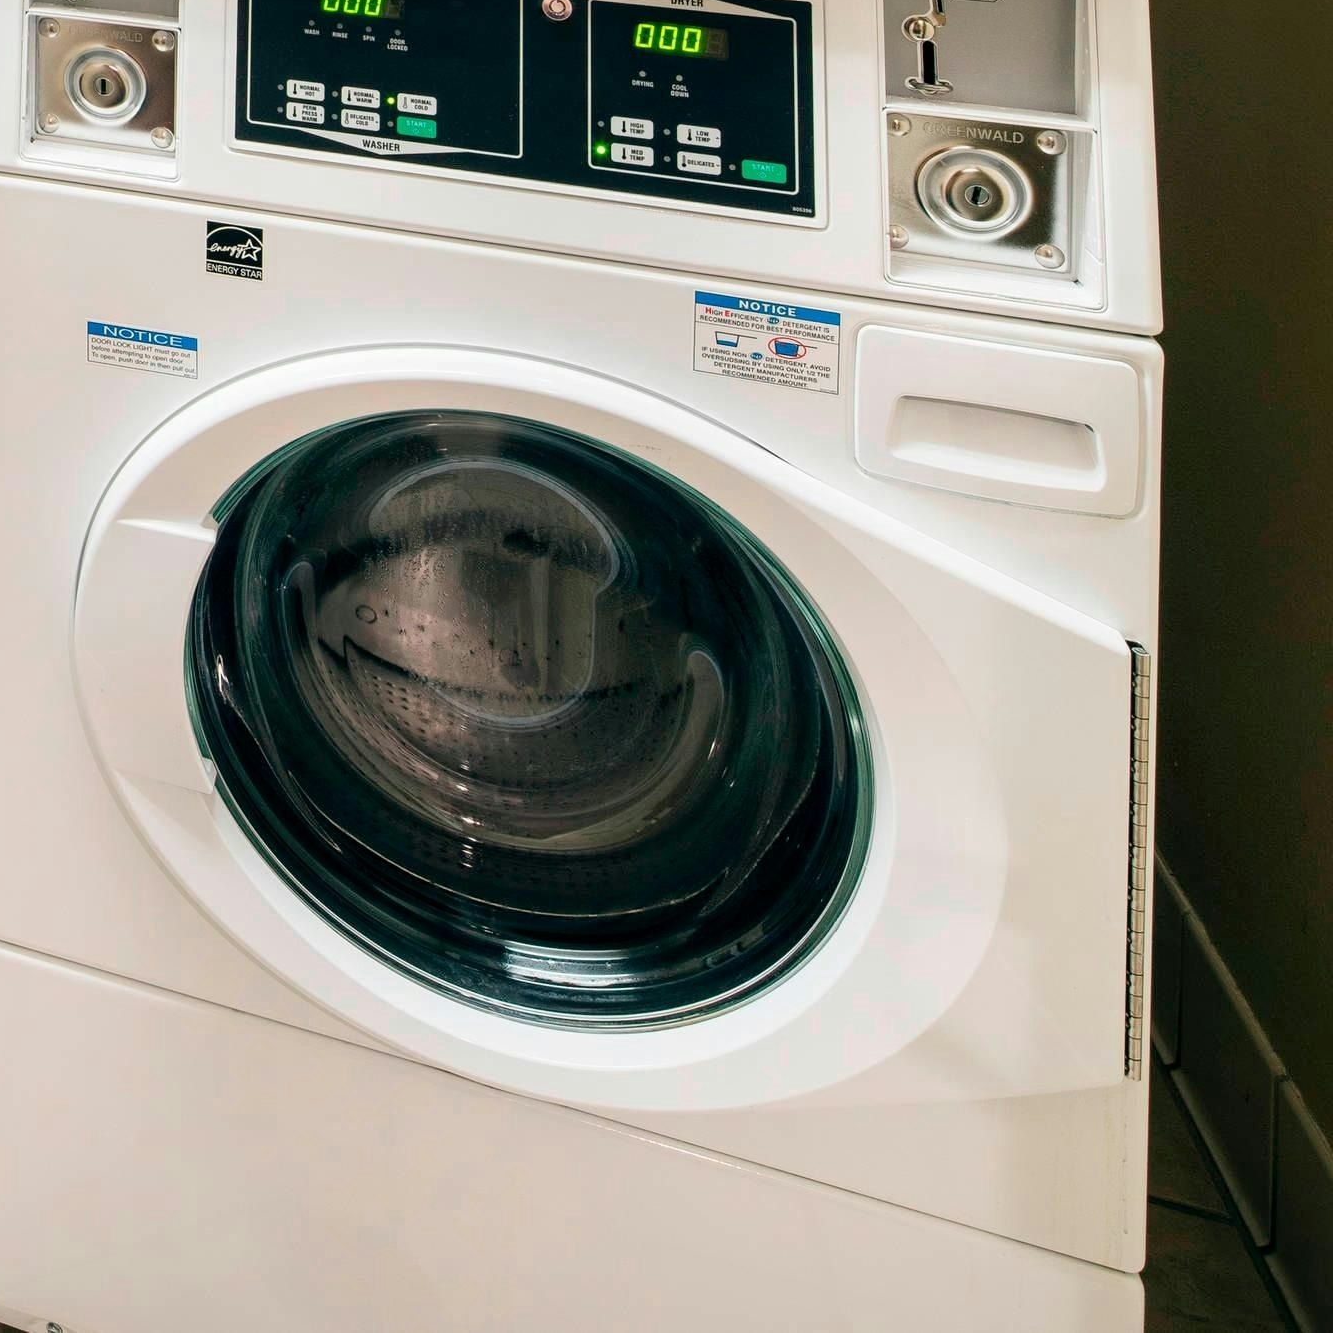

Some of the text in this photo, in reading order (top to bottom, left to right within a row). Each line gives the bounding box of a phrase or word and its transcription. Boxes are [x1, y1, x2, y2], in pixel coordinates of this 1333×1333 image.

[635, 23, 701, 52] 000
[632, 80, 654, 88] DRYING
[672, 84, 687, 92] COOL
[406, 120, 426, 128] START
[924, 122, 1025, 145] GREENWALD
[362, 139, 400, 151] WASHER
[207, 263, 262, 279] ENERGY STAR
[738, 299, 796, 317] NOTICE
[699, 315, 835, 341] RECOMMENDED FOR BEST PERFORMANCE
[783, 321, 821, 332] DETERGENT
[104, 325, 182, 347] NOTICE
[701, 354, 752, 366] OVERSUDSING
[763, 362, 784, 371] USING
[787, 366, 804, 374] ONLY
[709, 347, 730, 356] USING
[810, 364, 830, 372] AVOID
[714, 361, 817, 383] DETERGENT MANUFACTURERS
[722, 369, 776, 383] RECOMMENDED
